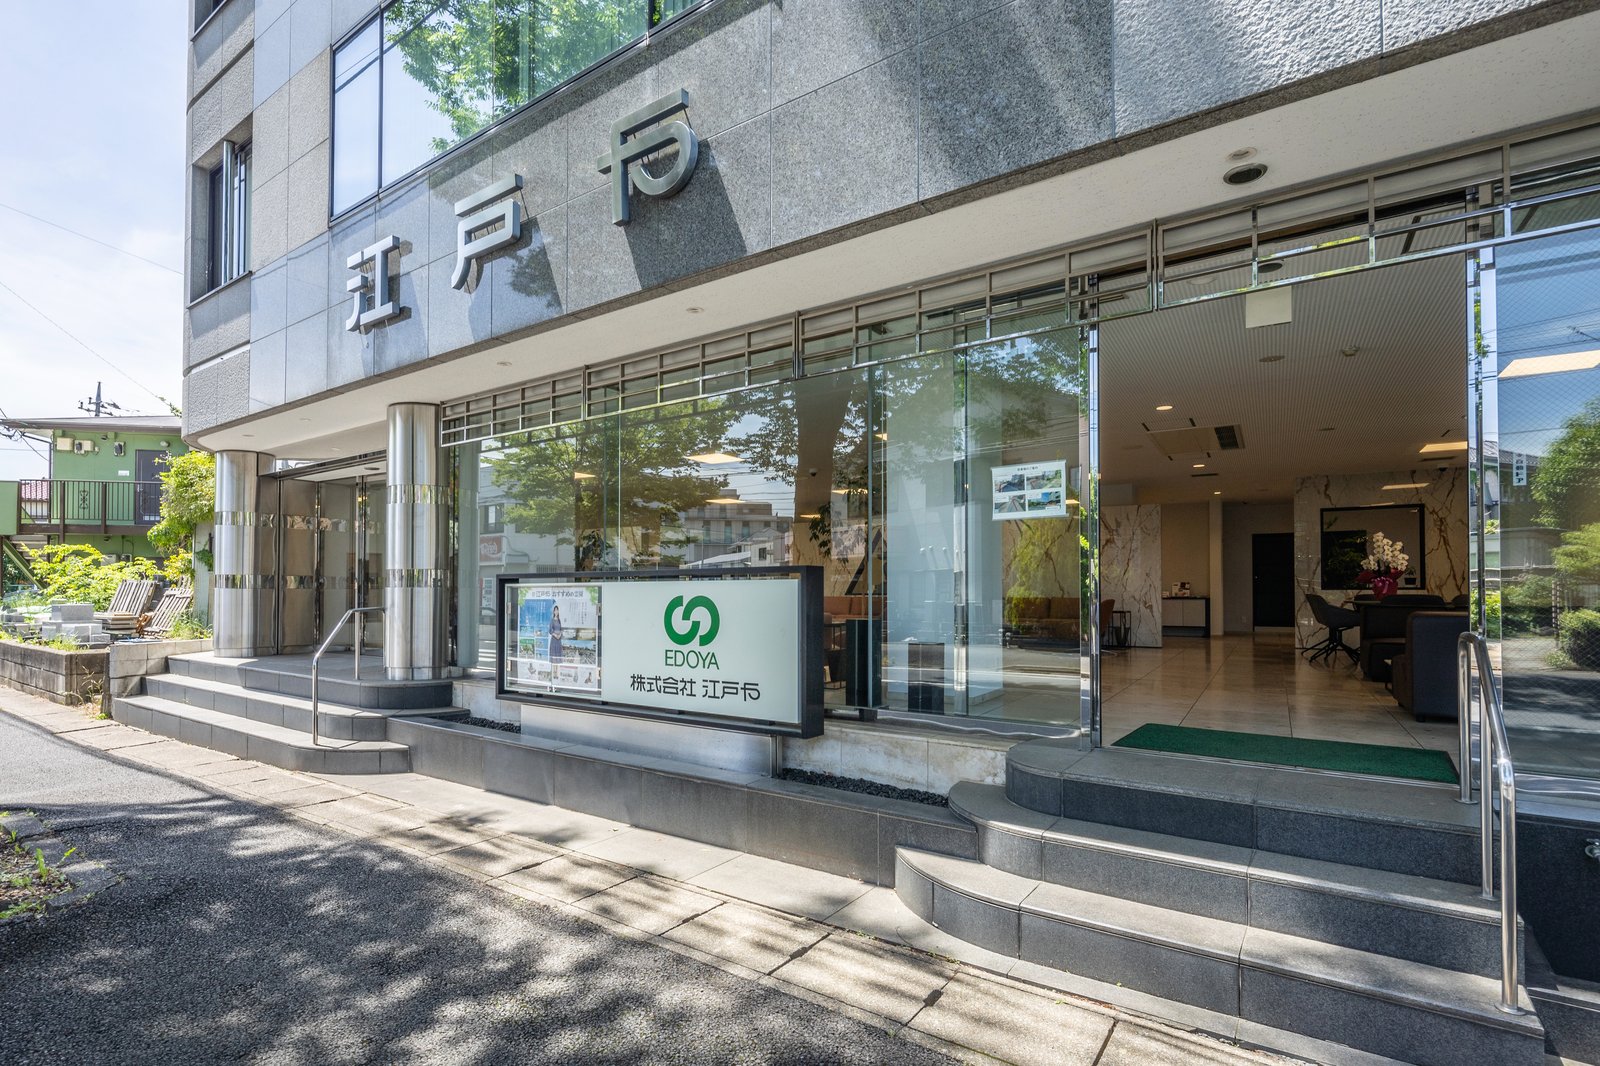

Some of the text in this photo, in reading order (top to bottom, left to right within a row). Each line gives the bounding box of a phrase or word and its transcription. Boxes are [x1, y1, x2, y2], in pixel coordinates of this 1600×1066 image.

[346, 87, 698, 333] 江戸や
[665, 650, 720, 670] EDOYA
[630, 674, 761, 702] 株式会社 江戸や
